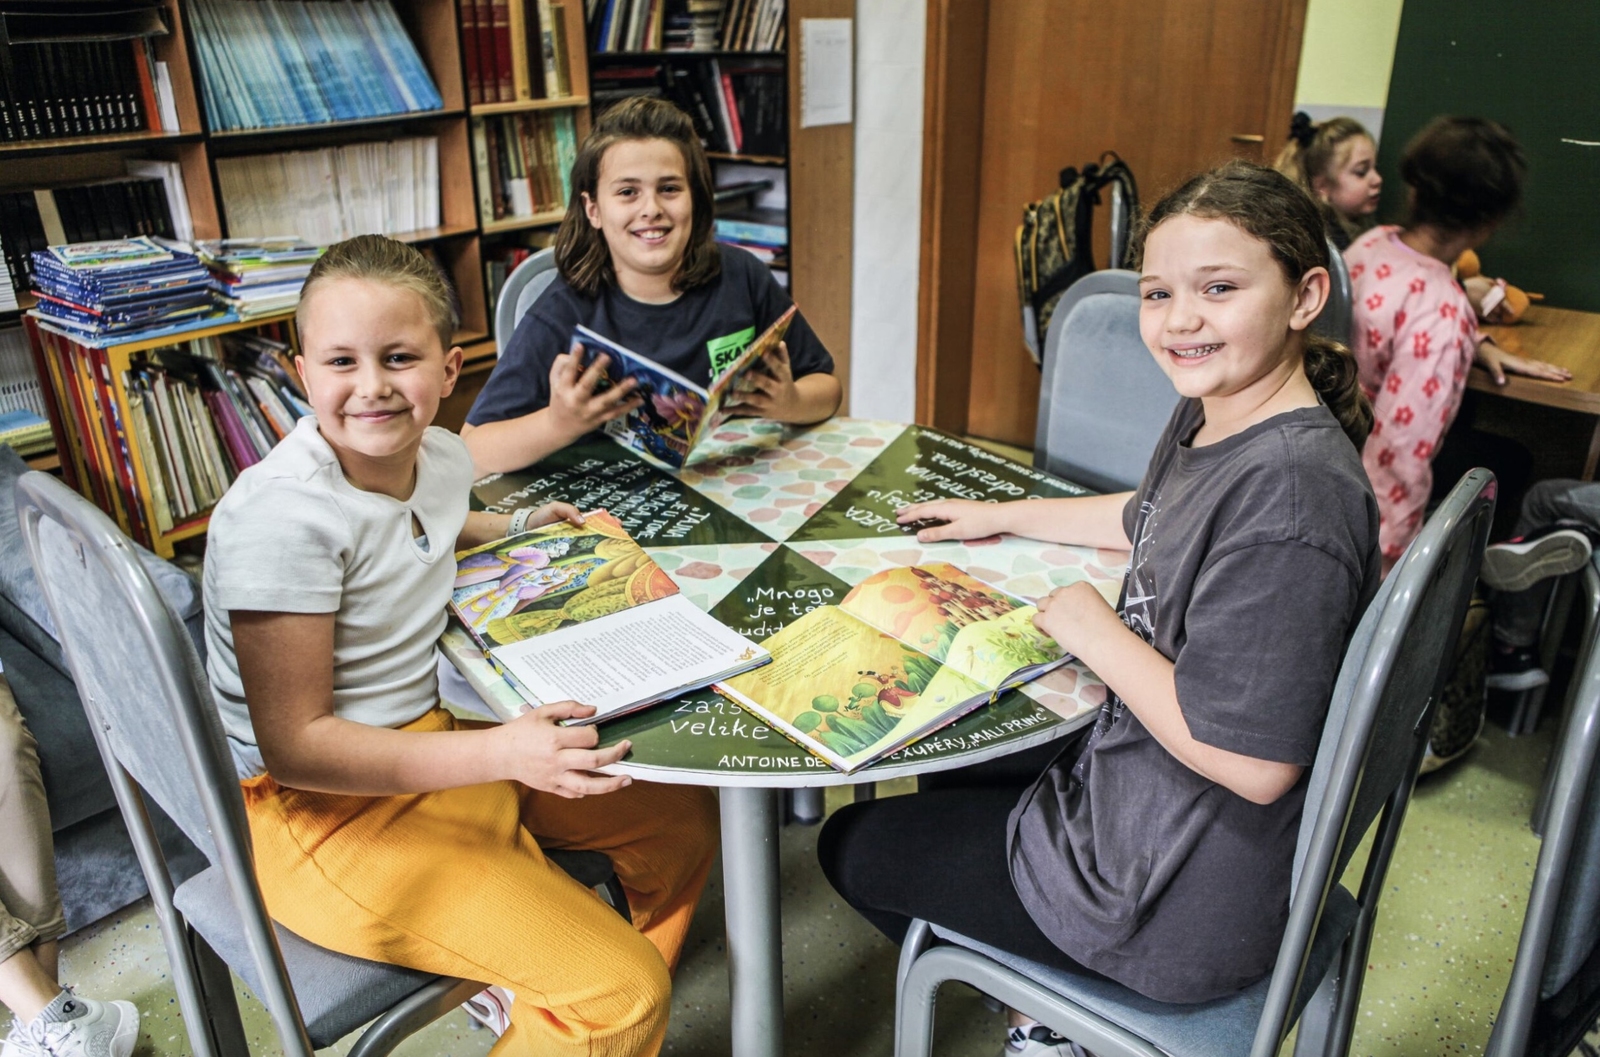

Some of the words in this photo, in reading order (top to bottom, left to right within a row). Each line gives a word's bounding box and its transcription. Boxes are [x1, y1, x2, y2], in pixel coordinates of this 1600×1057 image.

[905, 464, 985, 500] STRPLJIVA
[749, 605, 776, 619] je
[674, 699, 748, 715] zais
[718, 755, 801, 768] ANTOINE
[804, 756, 826, 768] DE
